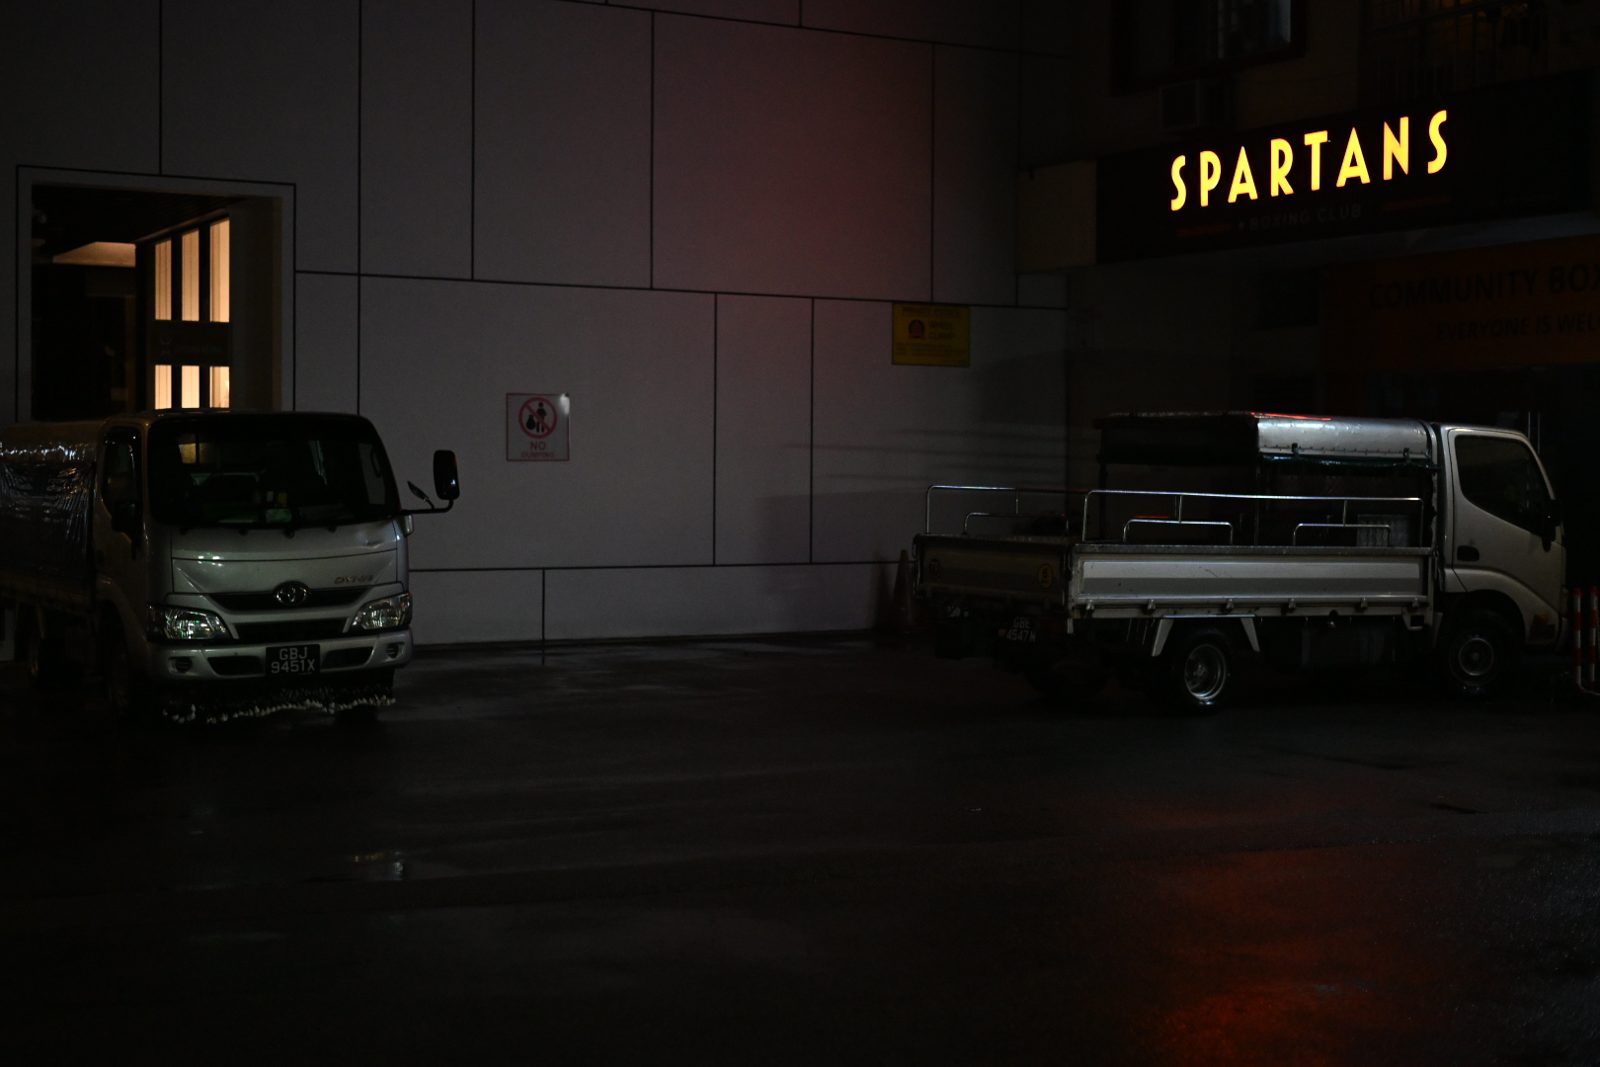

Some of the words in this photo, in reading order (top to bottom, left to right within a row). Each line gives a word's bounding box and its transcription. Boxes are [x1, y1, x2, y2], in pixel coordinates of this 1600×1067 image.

[1169, 108, 1449, 213] SPARTANS
[1248, 208, 1312, 232] BOXING
[1316, 201, 1361, 223] CLUB
[1368, 270, 1538, 312] COMMUNITY
[1437, 316, 1530, 340] EVERYONE
[1536, 314, 1553, 336] IS
[1557, 311, 1600, 334] WEL
[530, 441, 546, 451] NO
[271, 658, 316, 674] 9451X
[279, 646, 308, 660] GBJ
